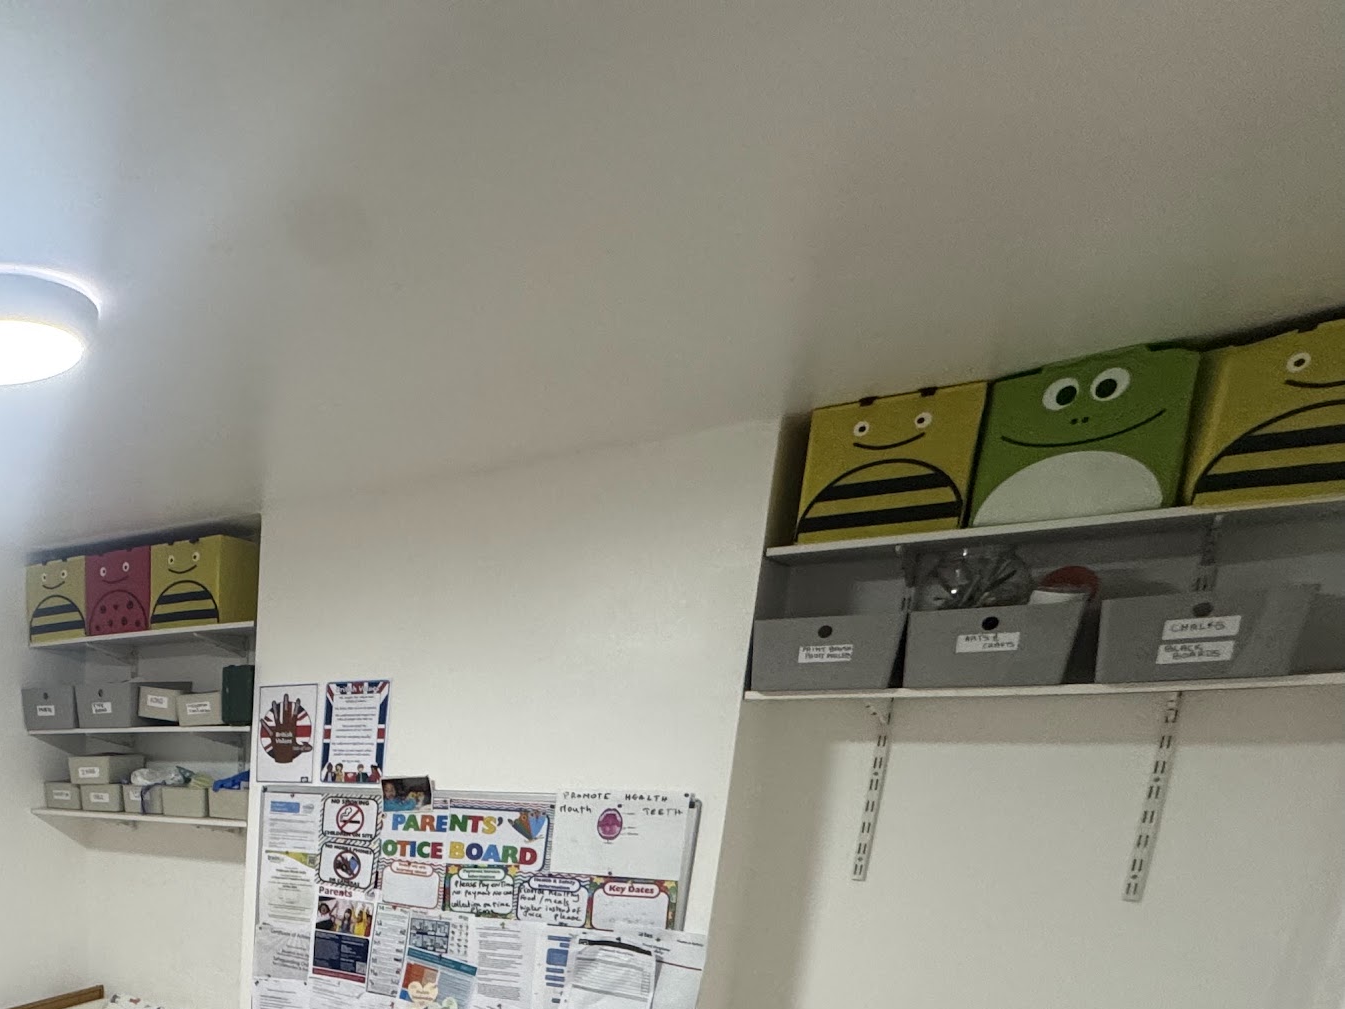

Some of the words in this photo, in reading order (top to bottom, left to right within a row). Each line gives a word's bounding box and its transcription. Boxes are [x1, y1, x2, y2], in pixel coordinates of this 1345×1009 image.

[1172, 649, 1222, 660] BOARDS
[562, 791, 611, 800] PROMOTE
[625, 793, 668, 802] HEALTH
[642, 807, 684, 816] TEETH
[382, 839, 443, 859] OTICE
[449, 841, 538, 865] BOARD
[318, 885, 353, 898] Parents
[609, 885, 627, 896] Key
[628, 885, 655, 894] Dates
